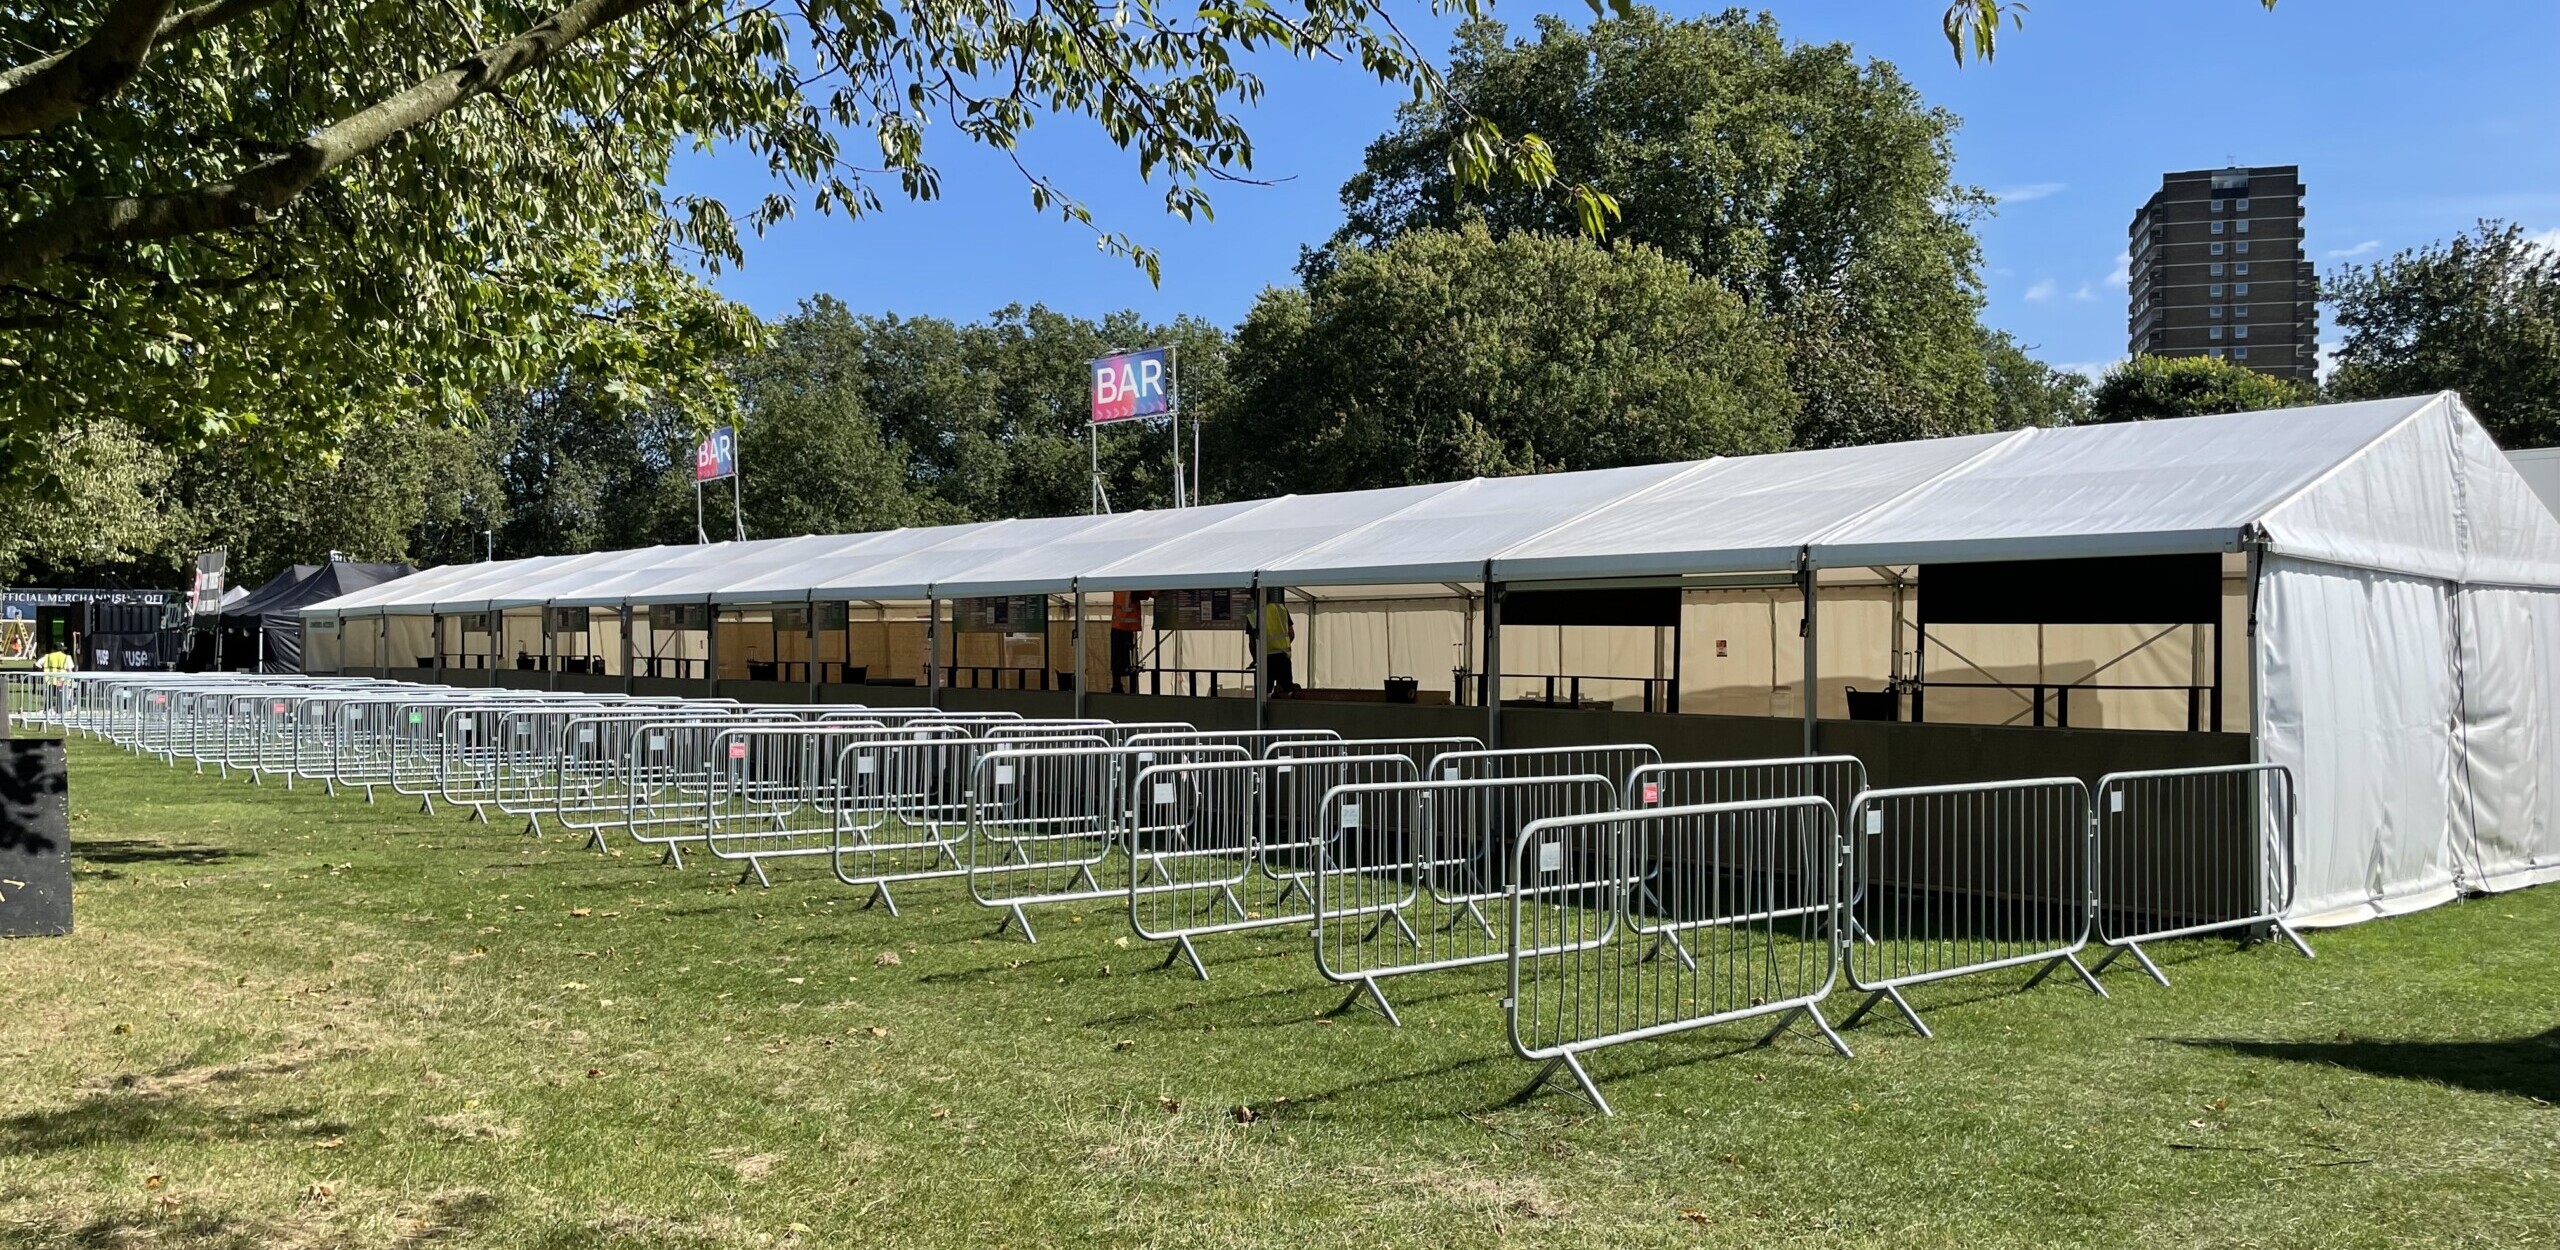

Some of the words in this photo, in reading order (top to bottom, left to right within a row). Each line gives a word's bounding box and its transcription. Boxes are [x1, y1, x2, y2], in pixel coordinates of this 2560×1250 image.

[1097, 359, 1163, 404] BAR
[698, 435, 731, 467] BAR
[2, 592, 44, 602] FFICIAL
